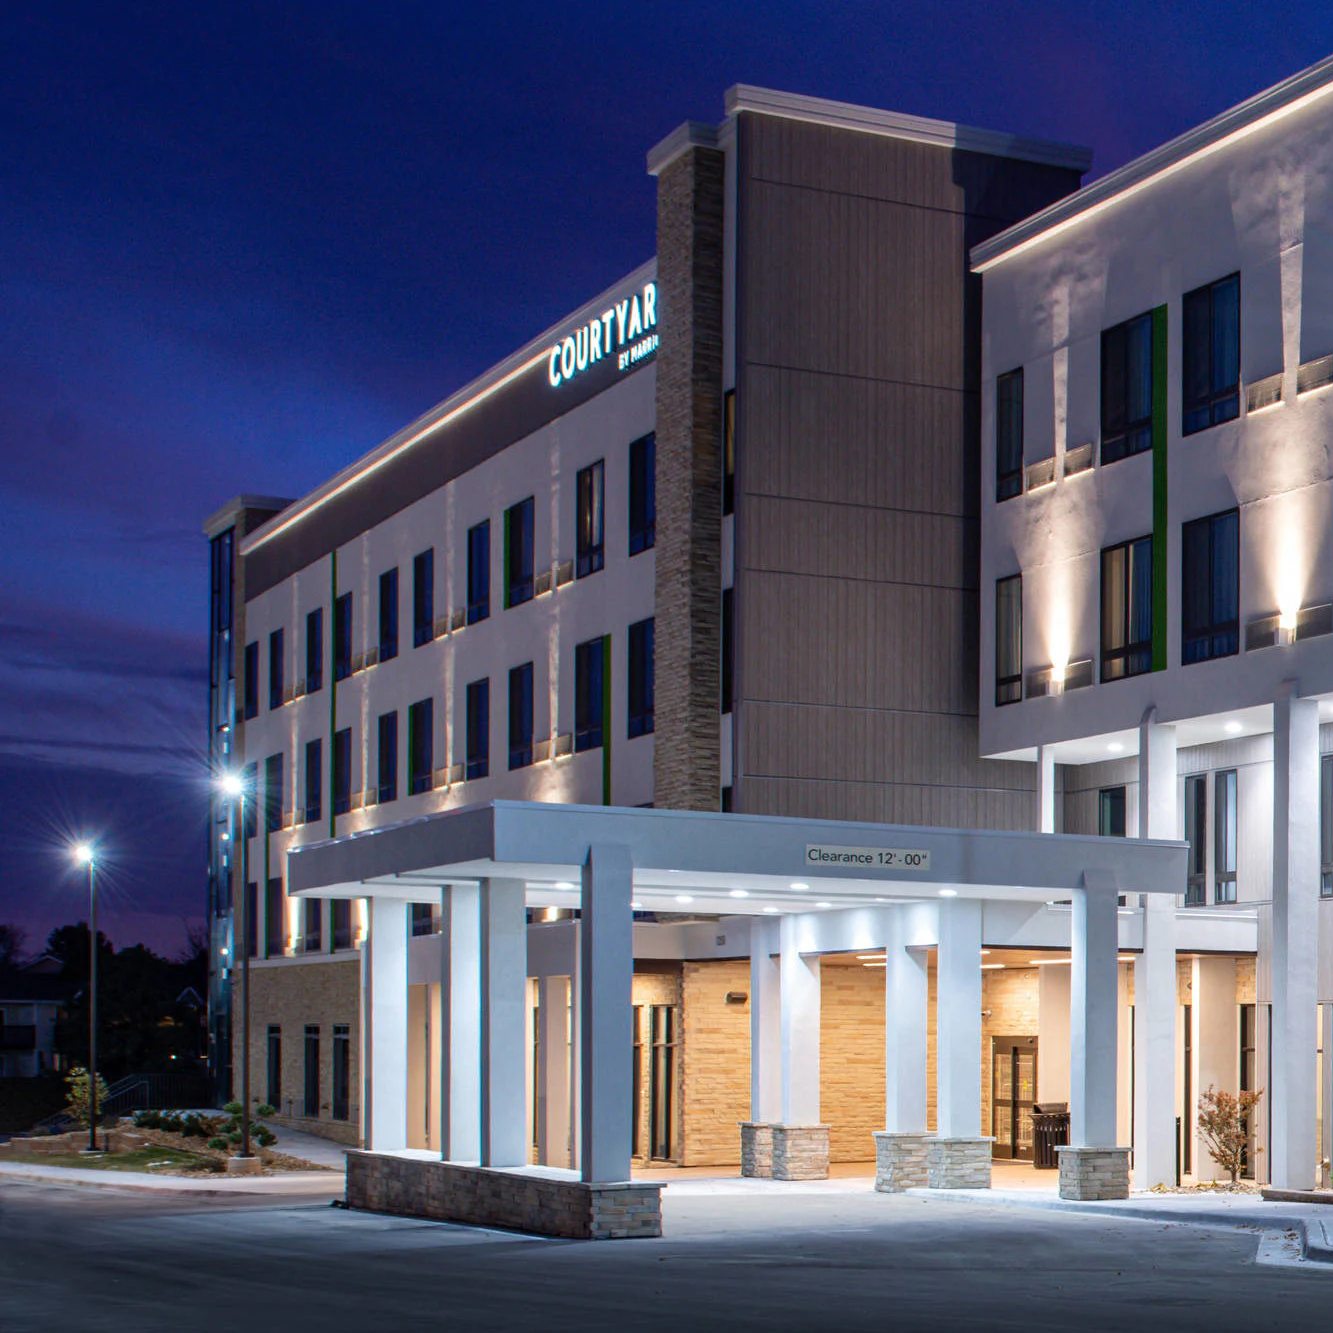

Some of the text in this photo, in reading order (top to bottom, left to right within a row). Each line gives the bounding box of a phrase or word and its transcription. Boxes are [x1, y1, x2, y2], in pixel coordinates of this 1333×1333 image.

[548, 282, 657, 388] COURTYAR
[618, 350, 630, 370] BY
[808, 848, 873, 864] Clearance
